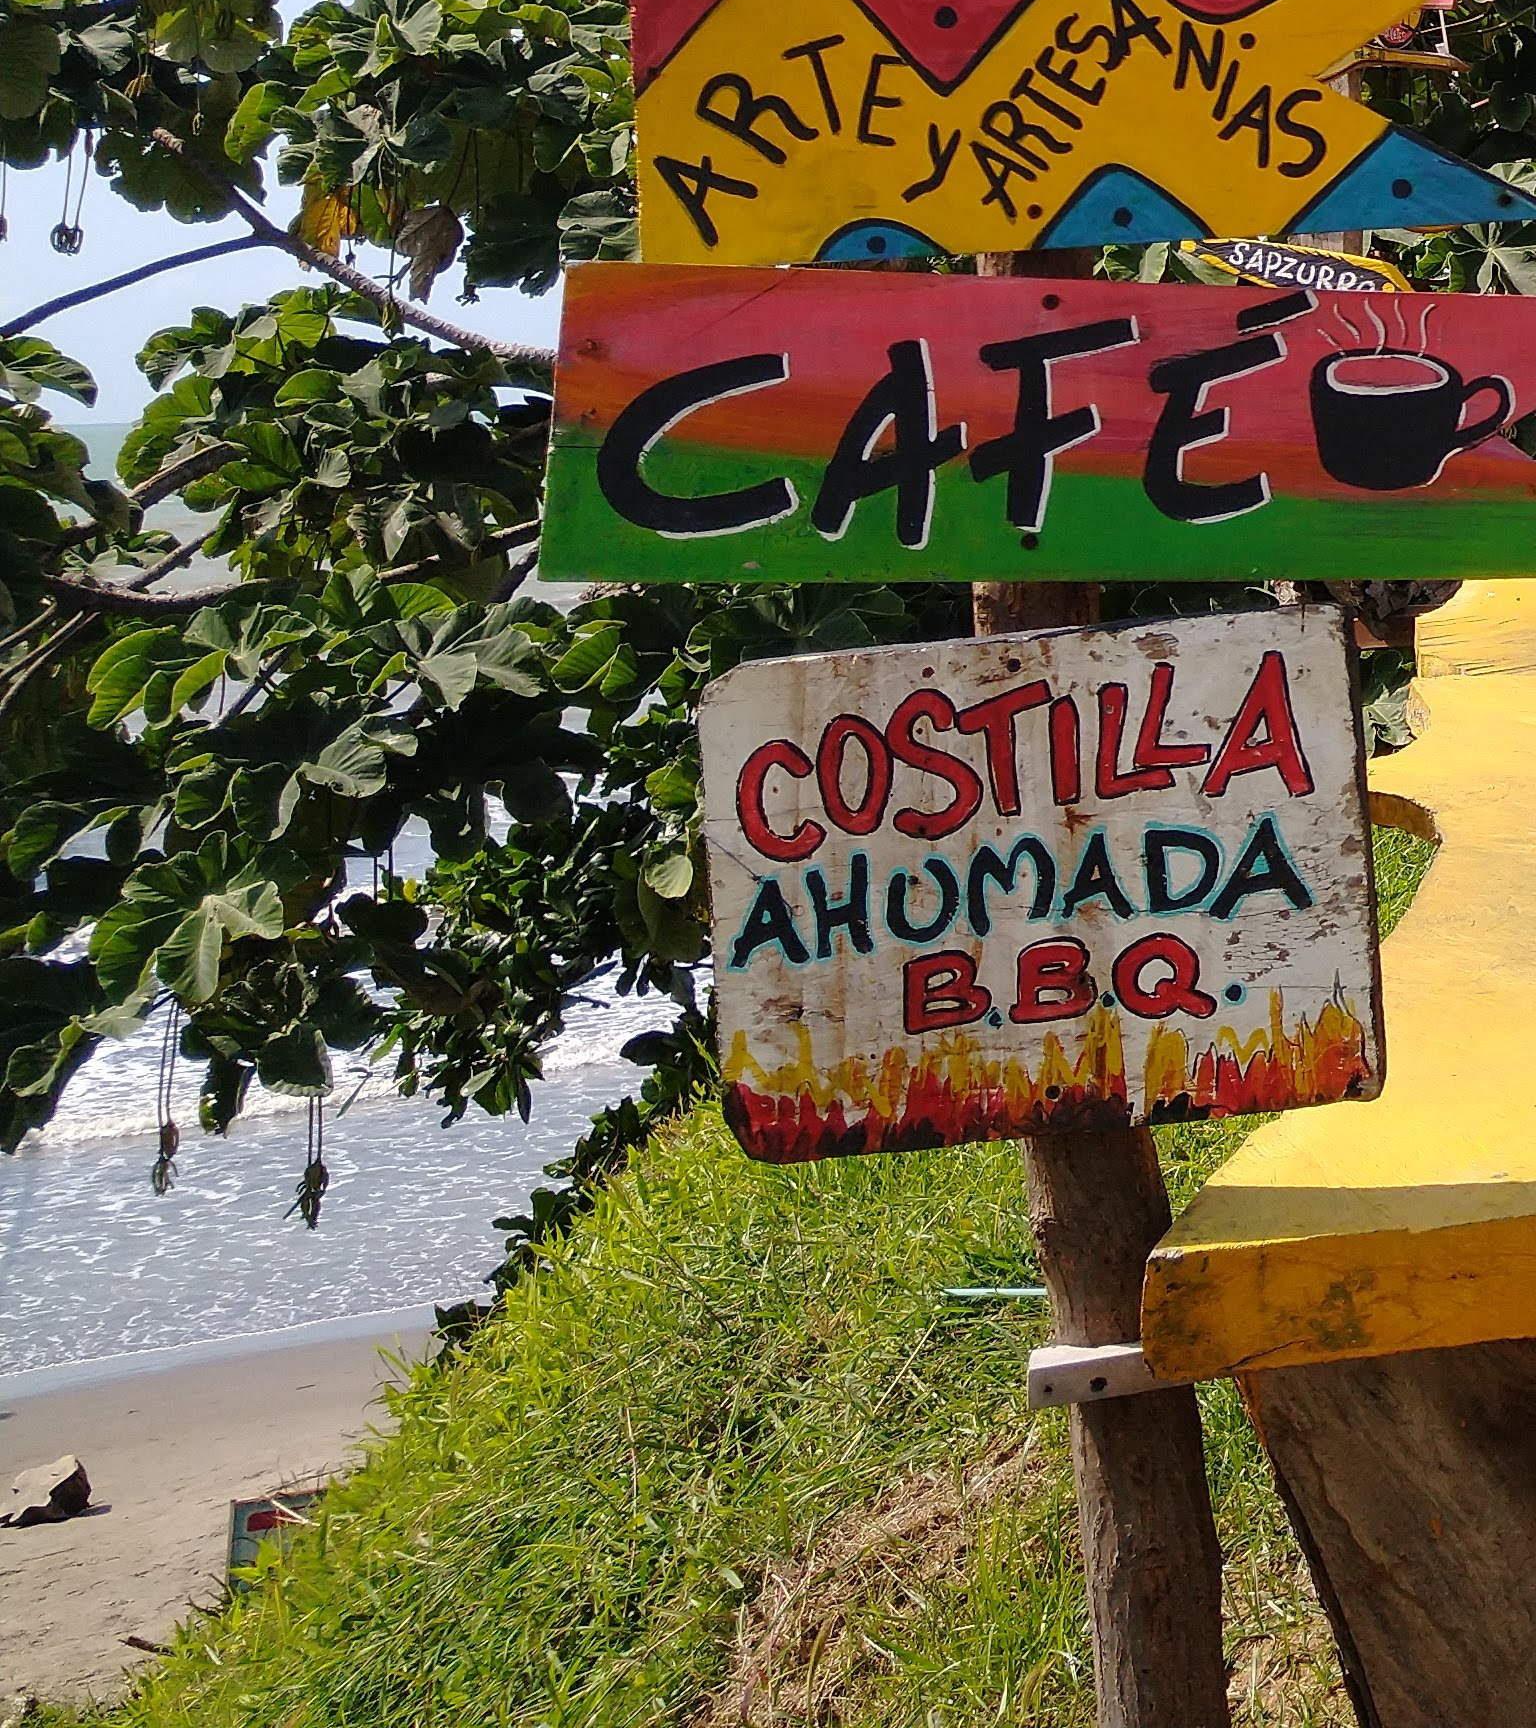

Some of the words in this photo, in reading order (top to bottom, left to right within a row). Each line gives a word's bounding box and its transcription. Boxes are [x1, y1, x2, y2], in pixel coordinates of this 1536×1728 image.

[653, 33, 912, 248] ARTE
[597, 288, 1319, 552] CAFÉ
[734, 648, 1317, 864] COSTILLA
[727, 812, 1318, 972] AHUMADA
